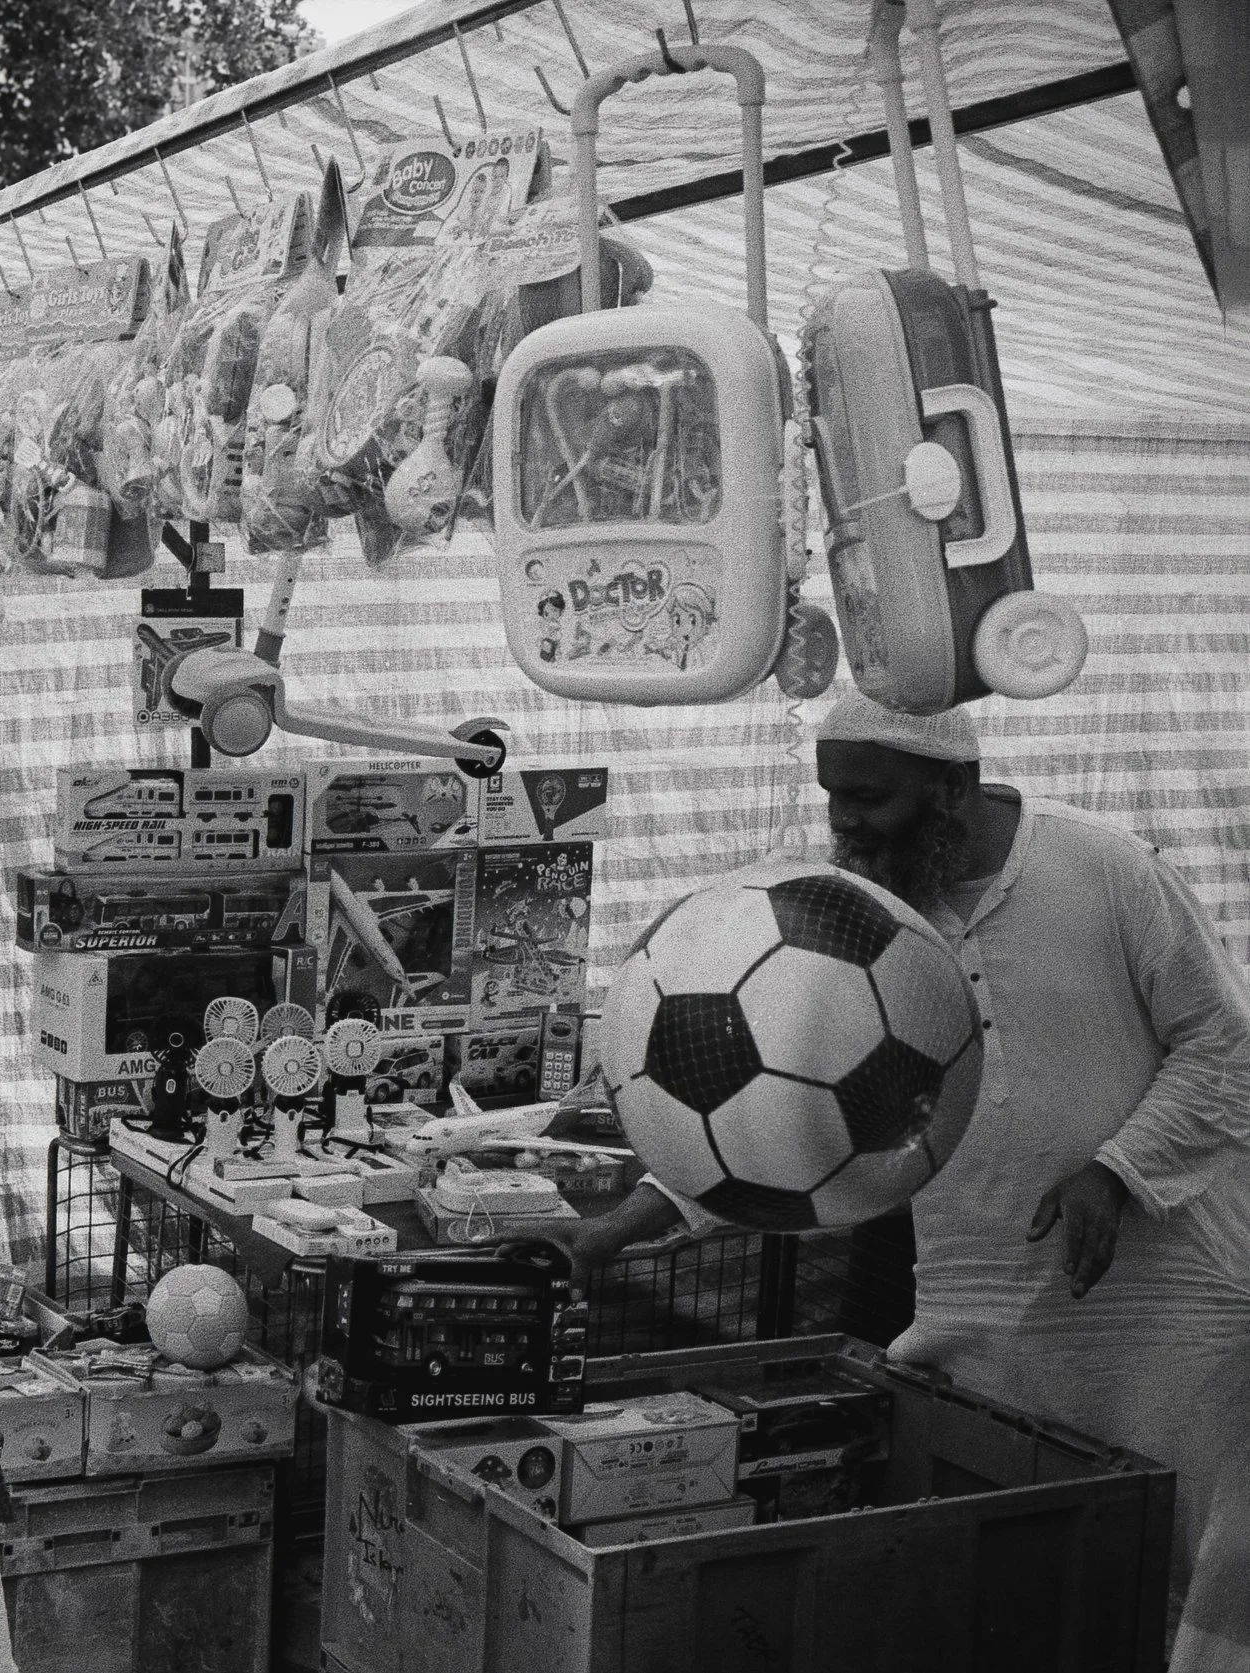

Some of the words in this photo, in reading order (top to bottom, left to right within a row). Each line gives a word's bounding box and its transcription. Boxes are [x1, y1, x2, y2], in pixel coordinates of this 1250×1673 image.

[392, 157, 434, 189] Baby
[568, 569, 666, 612] DOCTOR
[368, 761, 422, 771] HELICOPTER
[73, 820, 140, 831] HIGH-SPEED
[537, 861, 589, 882] PENGUIN
[537, 873, 585, 891] RACE
[75, 935, 158, 949] SUPERIOR
[296, 956, 314, 966] R/C
[117, 1058, 156, 1075] AMG
[98, 1085, 126, 1098] BUS
[382, 1264, 398, 1274] TRY
[399, 1263, 412, 1273] ME
[483, 1352, 505, 1366] BUS
[410, 1393, 505, 1408] SIGHTSEEING
[508, 1392, 536, 1406] BUS
